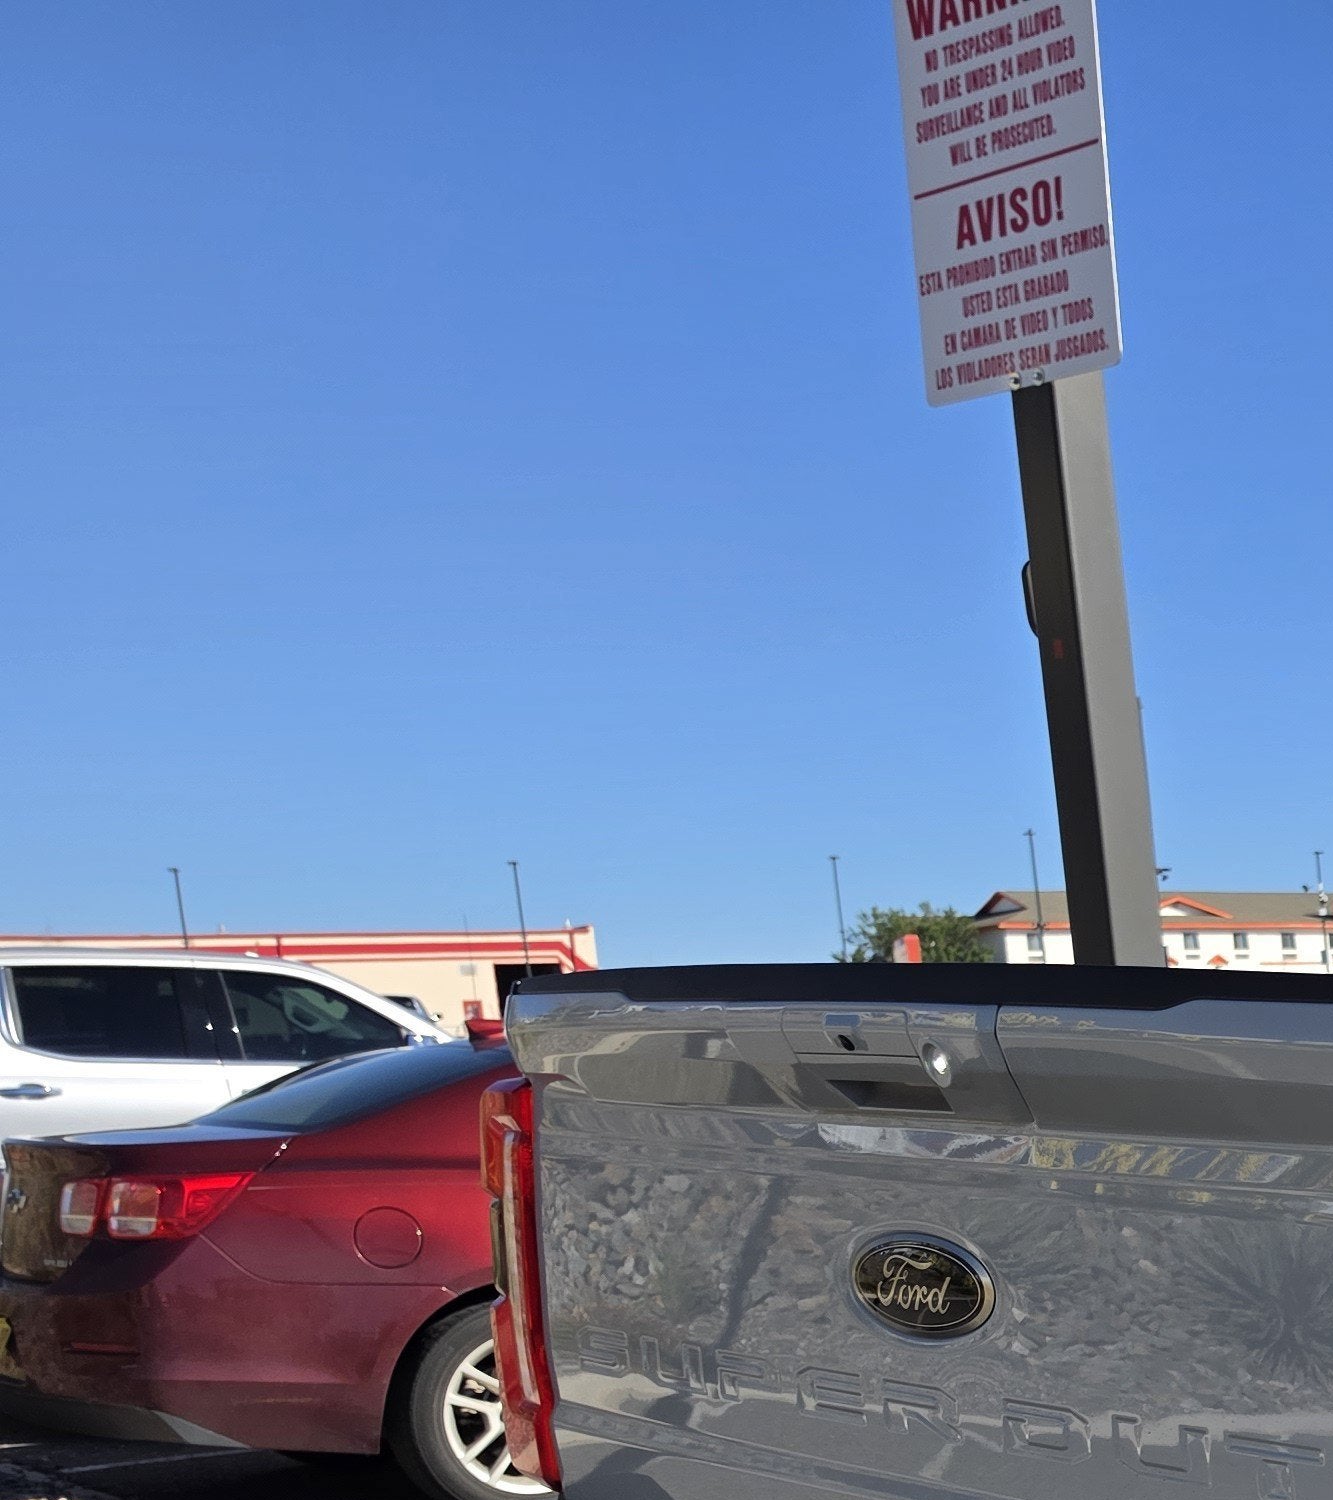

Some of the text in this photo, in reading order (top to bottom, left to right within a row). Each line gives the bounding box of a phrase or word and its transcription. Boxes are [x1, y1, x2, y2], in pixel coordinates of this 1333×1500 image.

[920, 35, 1076, 108] YOU ARE UNDER 24 HOUR VIDEO
[924, 49, 939, 73] NO
[942, 23, 1013, 67] TRESPASSING
[1018, 5, 1065, 41] ALLOWED.
[916, 67, 1086, 144] SURVEILLANCE AND ALL VIOLATORS
[950, 113, 1057, 166] WILL BE PROSECUTED.
[956, 175, 1064, 250] AVISO!
[919, 224, 1109, 297] ESTA PROHIBIDO ENTRAR SIN PERMISO.
[962, 269, 1069, 318] USTED ESTA GRABADO
[944, 297, 1094, 356] EN CAMARA DE VIDEO Y TODOS
[936, 366, 953, 391] LOS
[957, 352, 1016, 385] VIOLADORES
[1019, 343, 1052, 371] SERAN
[877, 1254, 951, 1315] Ford
[577, 1325, 963, 1444] SUPER
